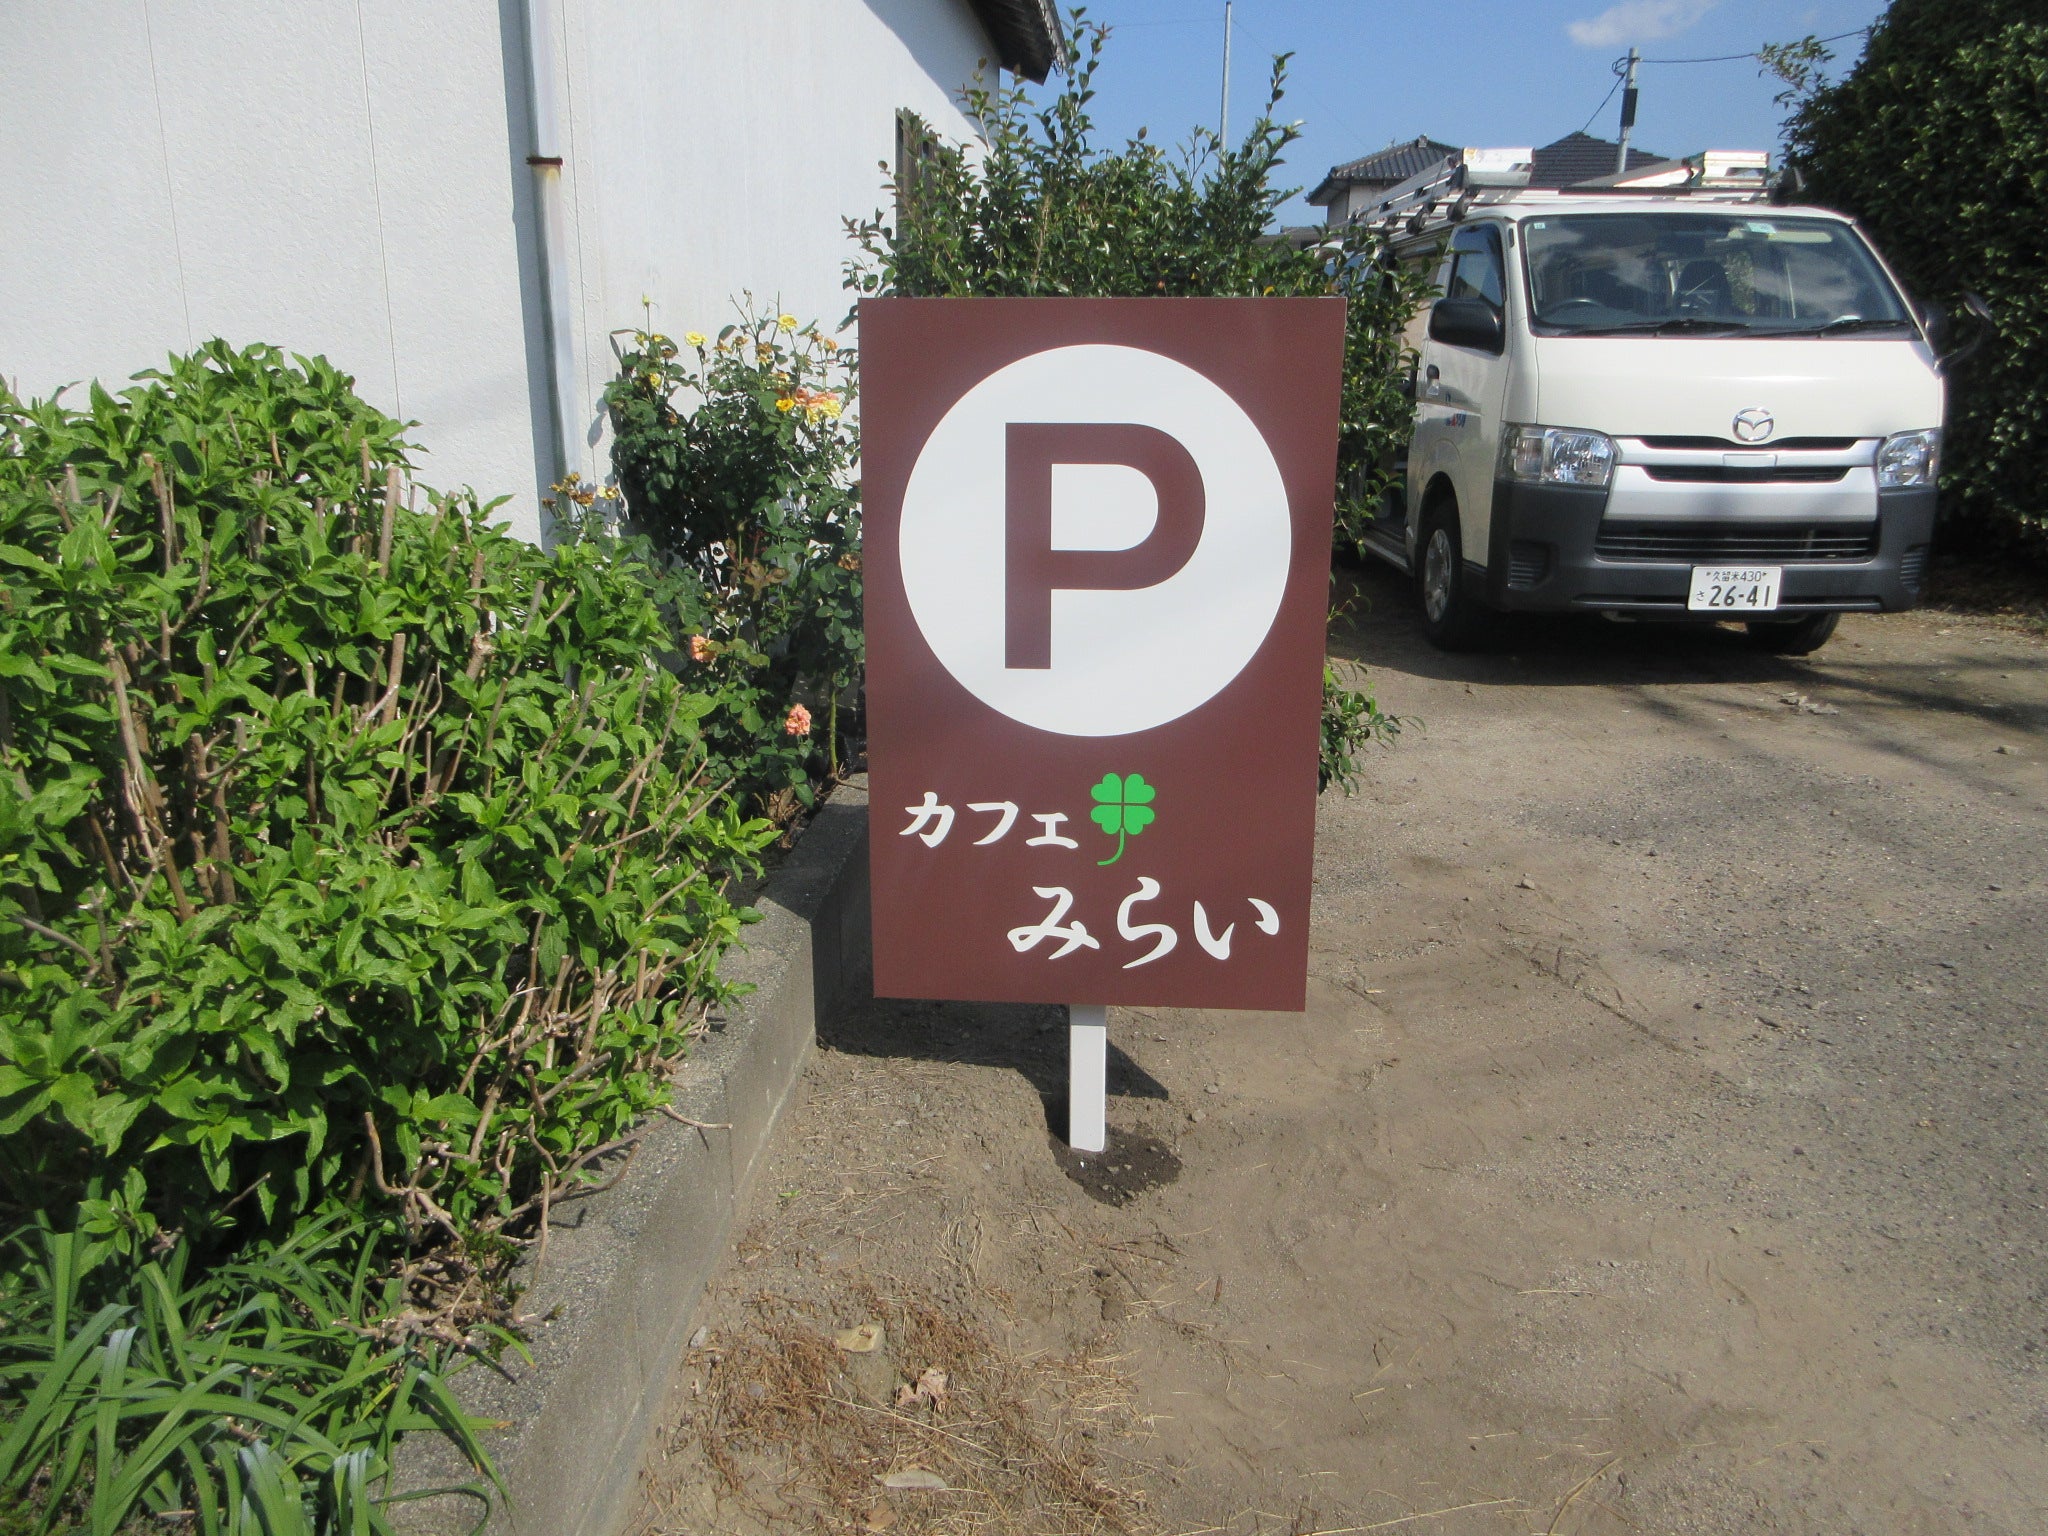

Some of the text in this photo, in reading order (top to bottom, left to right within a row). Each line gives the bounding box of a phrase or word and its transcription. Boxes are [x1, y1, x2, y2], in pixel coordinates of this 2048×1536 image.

[1005, 423, 1205, 669] P
[1708, 585, 1771, 607] 26-41
[898, 791, 1079, 849] カフェ
[1006, 876, 1280, 969] みらい
